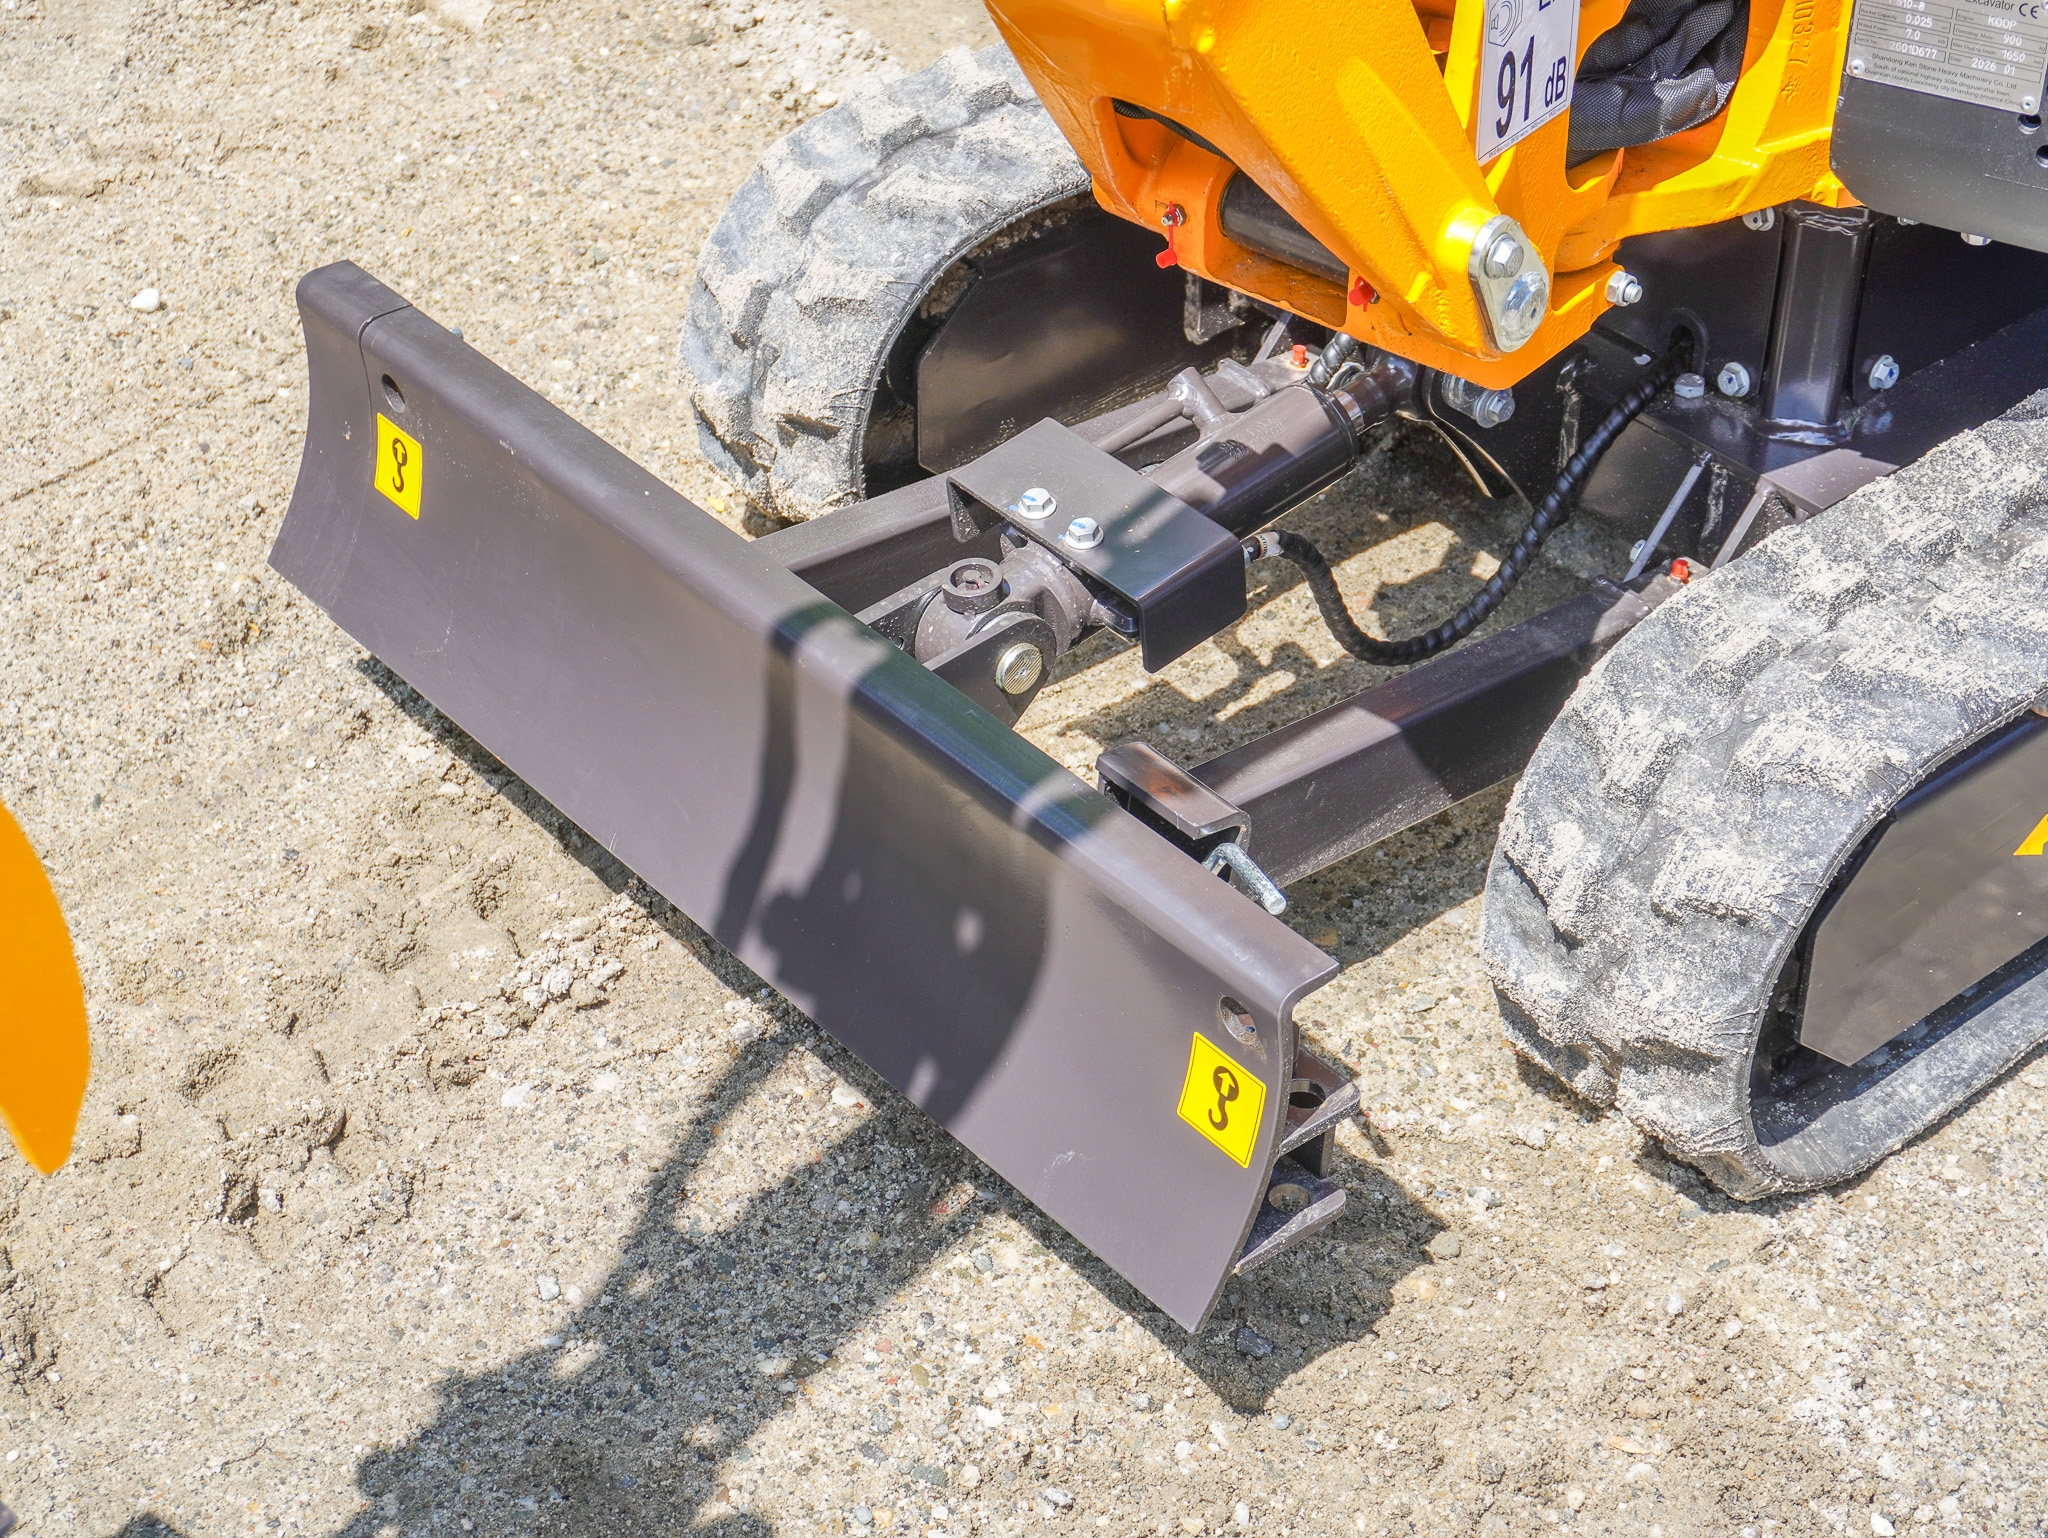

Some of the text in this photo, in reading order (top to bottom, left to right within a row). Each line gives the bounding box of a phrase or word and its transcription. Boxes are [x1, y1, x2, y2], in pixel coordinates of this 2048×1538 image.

[1965, 0, 2015, 11] xcavator
[1877, 12, 1898, 20] Capacity
[1905, 13, 1933, 28] 0.025
[1905, 28, 1921, 41] 7.0
[1955, 29, 1978, 38] Operating
[2003, 34, 2022, 47] 900
[2001, 50, 2026, 63] 1650
[1864, 68, 1890, 78] Guanxian
[1872, 52, 1903, 66] Shandong
[1904, 60, 1917, 68] Ken
[1918, 63, 1937, 73] Stone
[1938, 67, 1958, 78] Heavy
[1959, 72, 1992, 86] Machinery
[1873, 62, 1889, 71] South
[1898, 69, 1919, 77] national
[1920, 72, 1943, 83] highway
[1971, 57, 2016, 76] 2026 01
[1496, 35, 1535, 139] 91
[1544, 55, 1567, 108] dB
